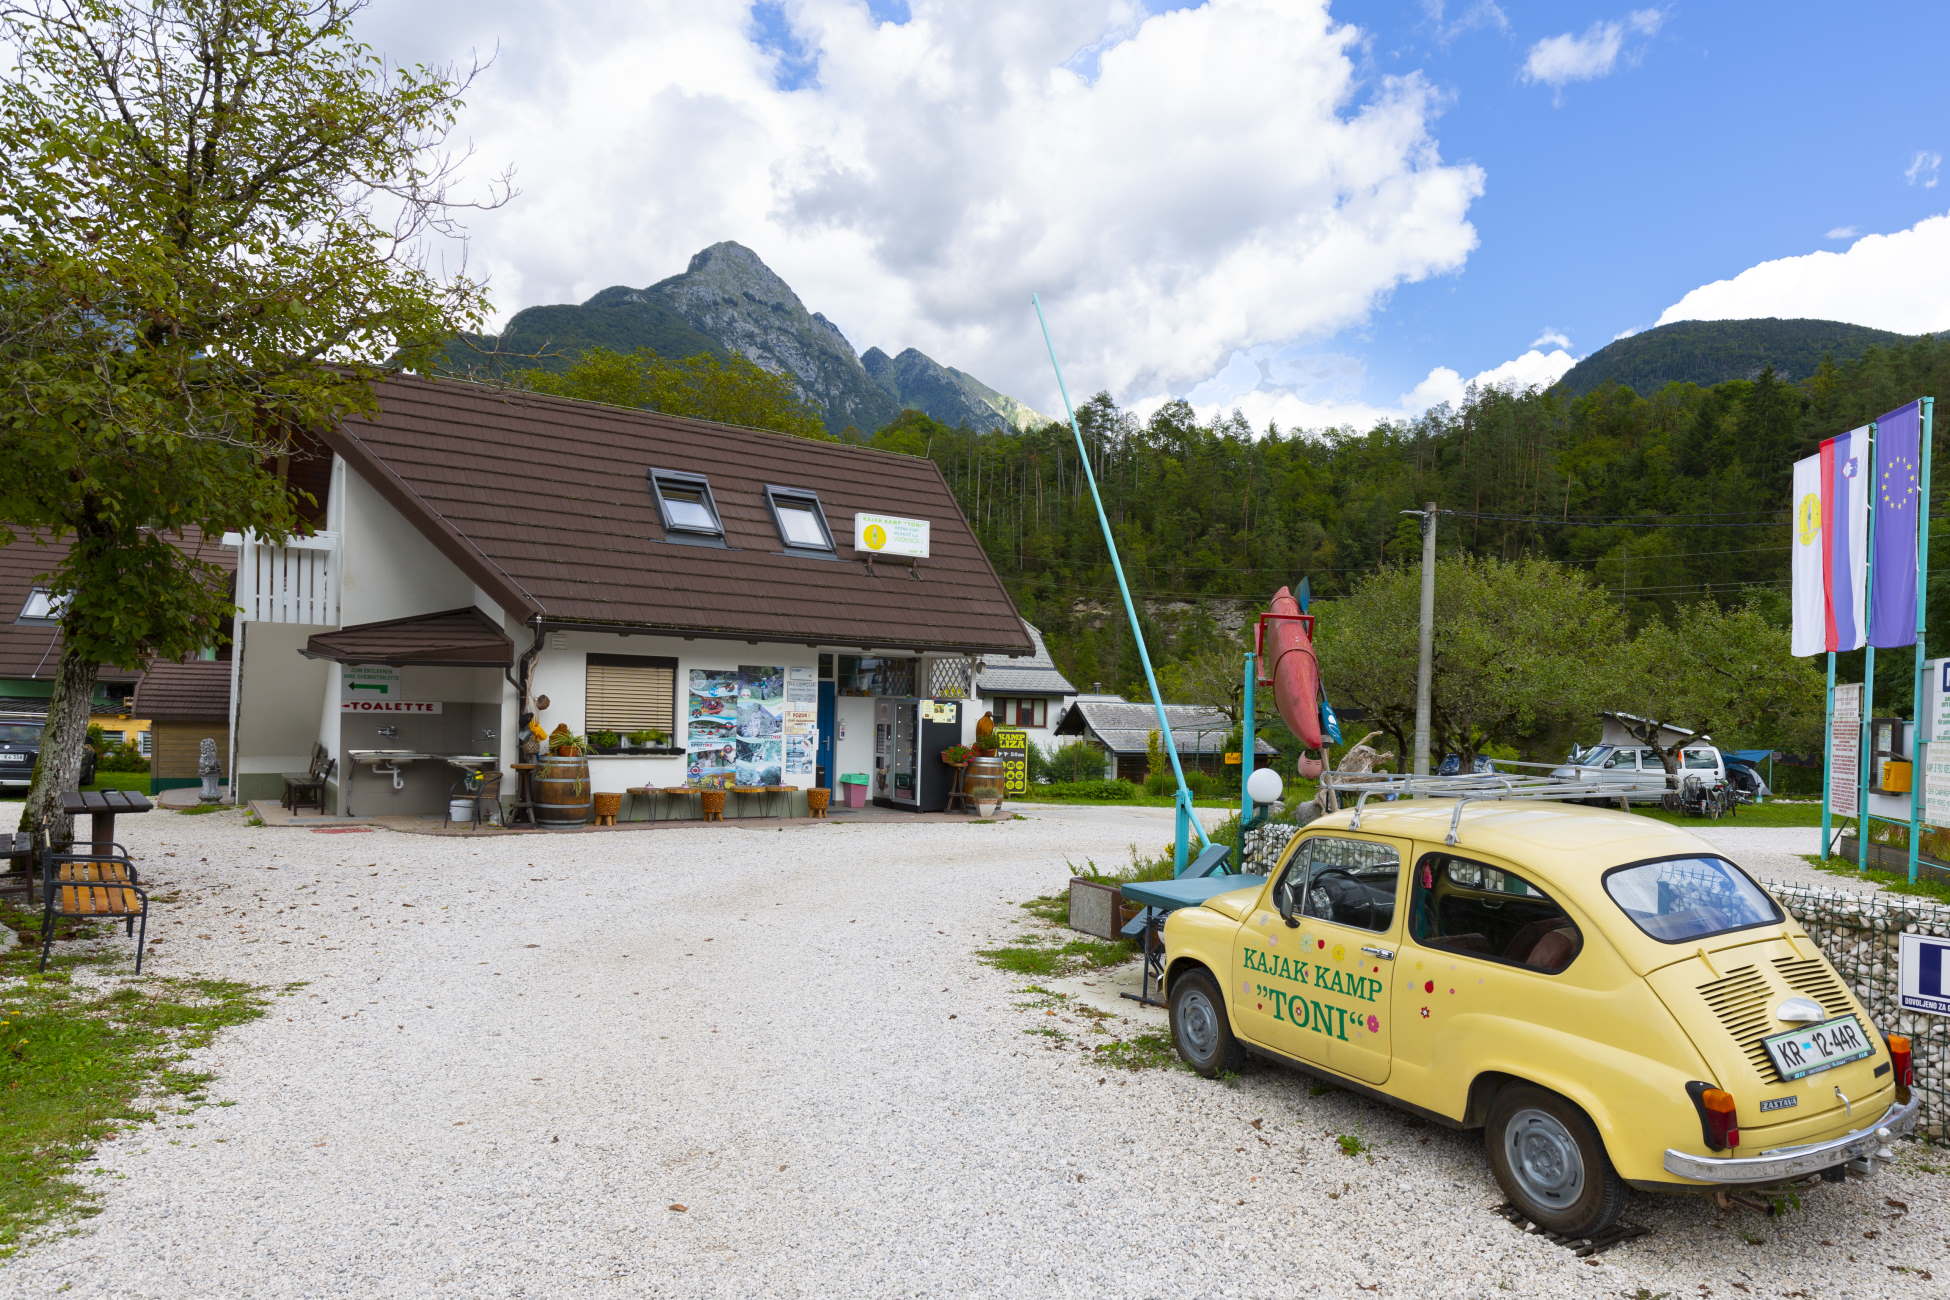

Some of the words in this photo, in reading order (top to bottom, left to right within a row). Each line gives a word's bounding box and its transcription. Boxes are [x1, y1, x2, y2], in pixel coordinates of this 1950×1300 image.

[350, 702, 434, 712] TOALETTE
[998, 733, 1025, 741] KAMP
[999, 740, 1025, 749] LIZA
[1243, 947, 1309, 984] KAJAK
[1313, 965, 1383, 1003] KAMP
[1904, 997, 1938, 1010] DOVOLJENO
[1938, 1003, 1947, 1012] ZA
[1777, 1040, 1807, 1069] KR
